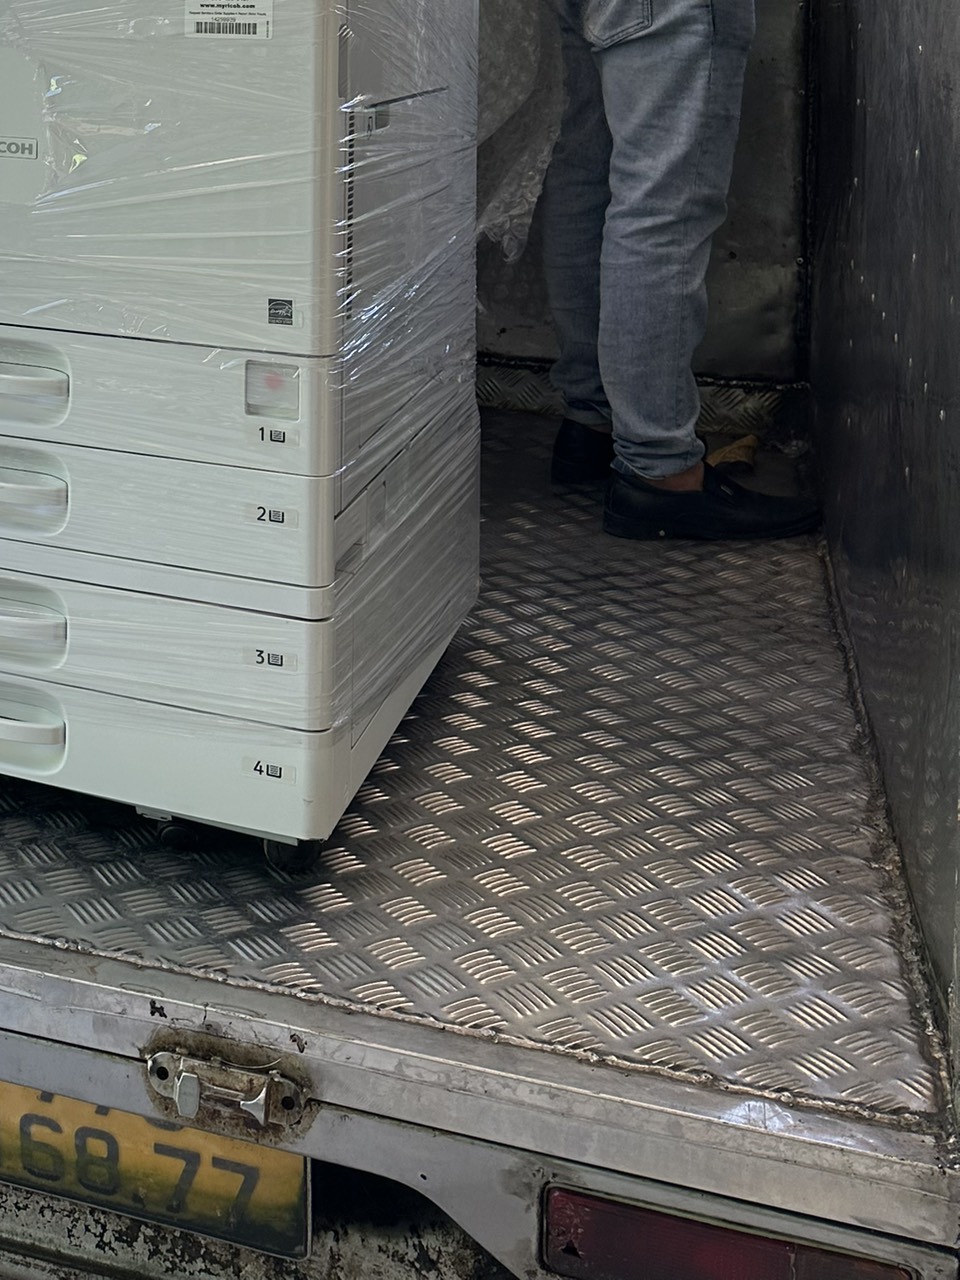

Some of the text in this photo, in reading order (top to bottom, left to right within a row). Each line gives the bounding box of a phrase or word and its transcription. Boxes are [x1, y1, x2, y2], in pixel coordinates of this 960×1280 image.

[259, 427, 265, 441] 1
[256, 506, 267, 521] 2
[255, 649, 265, 665] 3
[253, 760, 264, 776] 4
